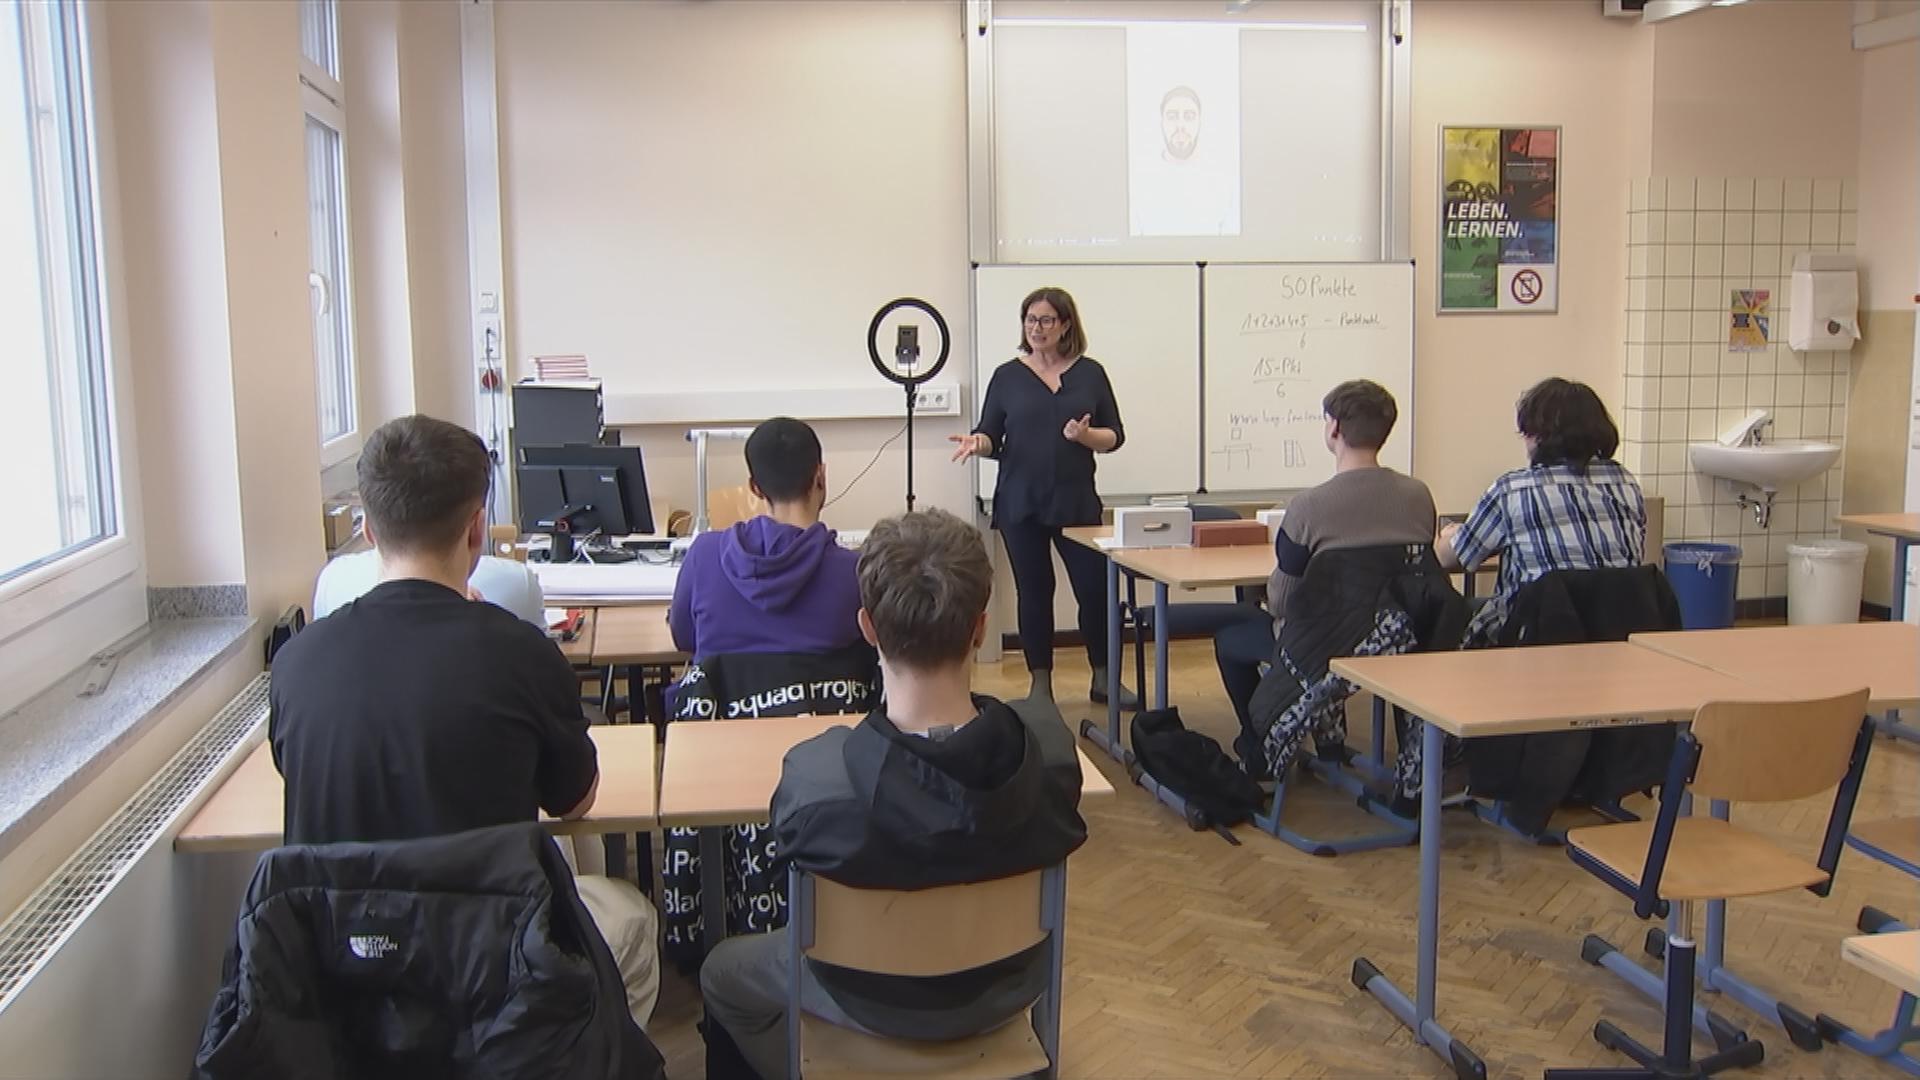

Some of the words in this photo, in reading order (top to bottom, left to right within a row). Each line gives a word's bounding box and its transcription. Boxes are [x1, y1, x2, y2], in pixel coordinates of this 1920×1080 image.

[1448, 202, 1509, 219] LEBEN.
[1448, 220, 1524, 239] LERNEN.
[1276, 382, 1287, 399] 6
